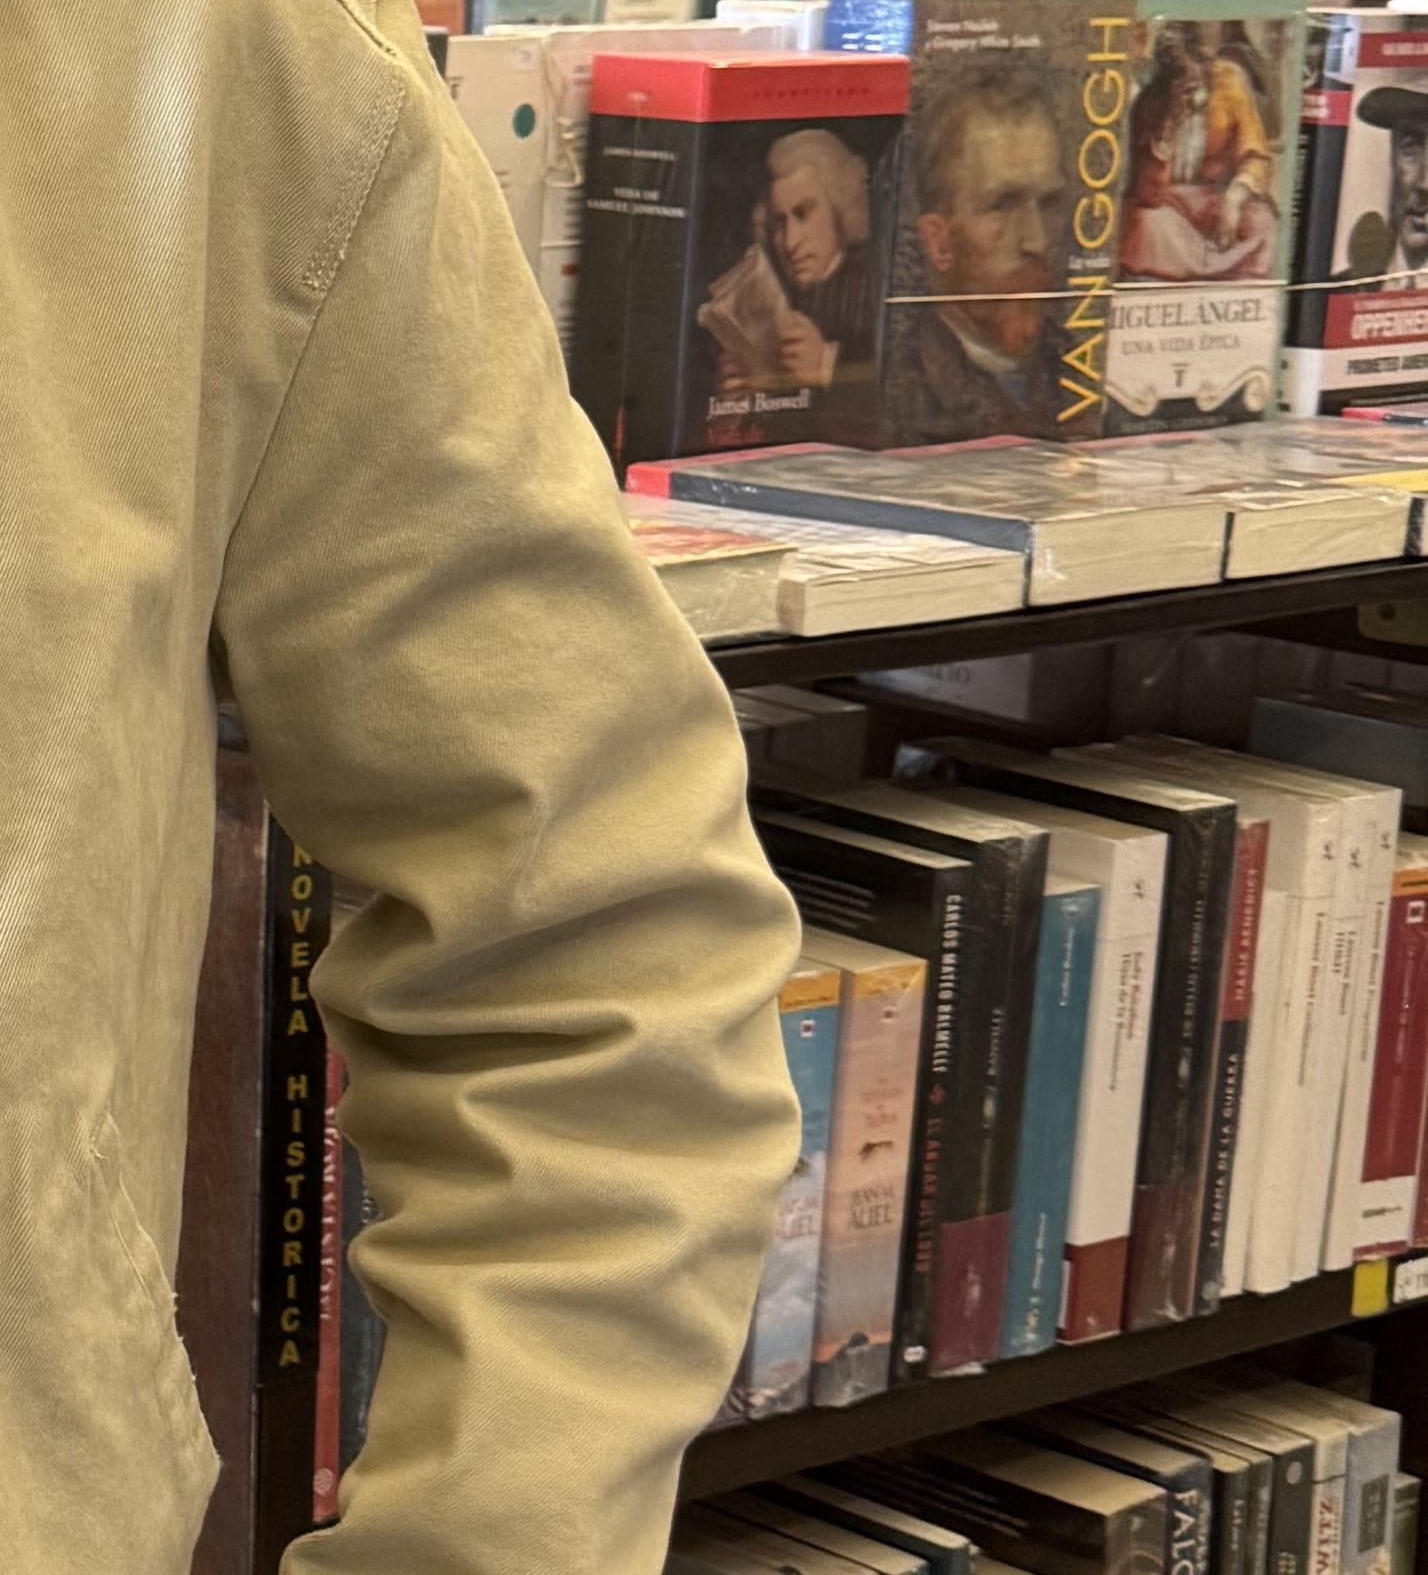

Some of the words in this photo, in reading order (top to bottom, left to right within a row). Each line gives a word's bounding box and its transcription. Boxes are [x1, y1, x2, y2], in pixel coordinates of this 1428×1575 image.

[1073, 17, 1131, 251] GOGH
[1196, 296, 1267, 326] ÁNGEL
[1056, 276, 1108, 423] VAN
[754, 388, 810, 413] Boswell
[288, 841, 315, 1037] NOVELA
[941, 894, 963, 949] CARLOS
[937, 952, 958, 1001] MATEO
[1221, 1052, 1239, 1118] GUERRA
[1219, 1123, 1233, 1145] LA
[1216, 1149, 1230, 1171] DE
[279, 1075, 309, 1368] HISTORICA
[1210, 1176, 1227, 1223] DAMA
[1207, 1229, 1222, 1249] LA
